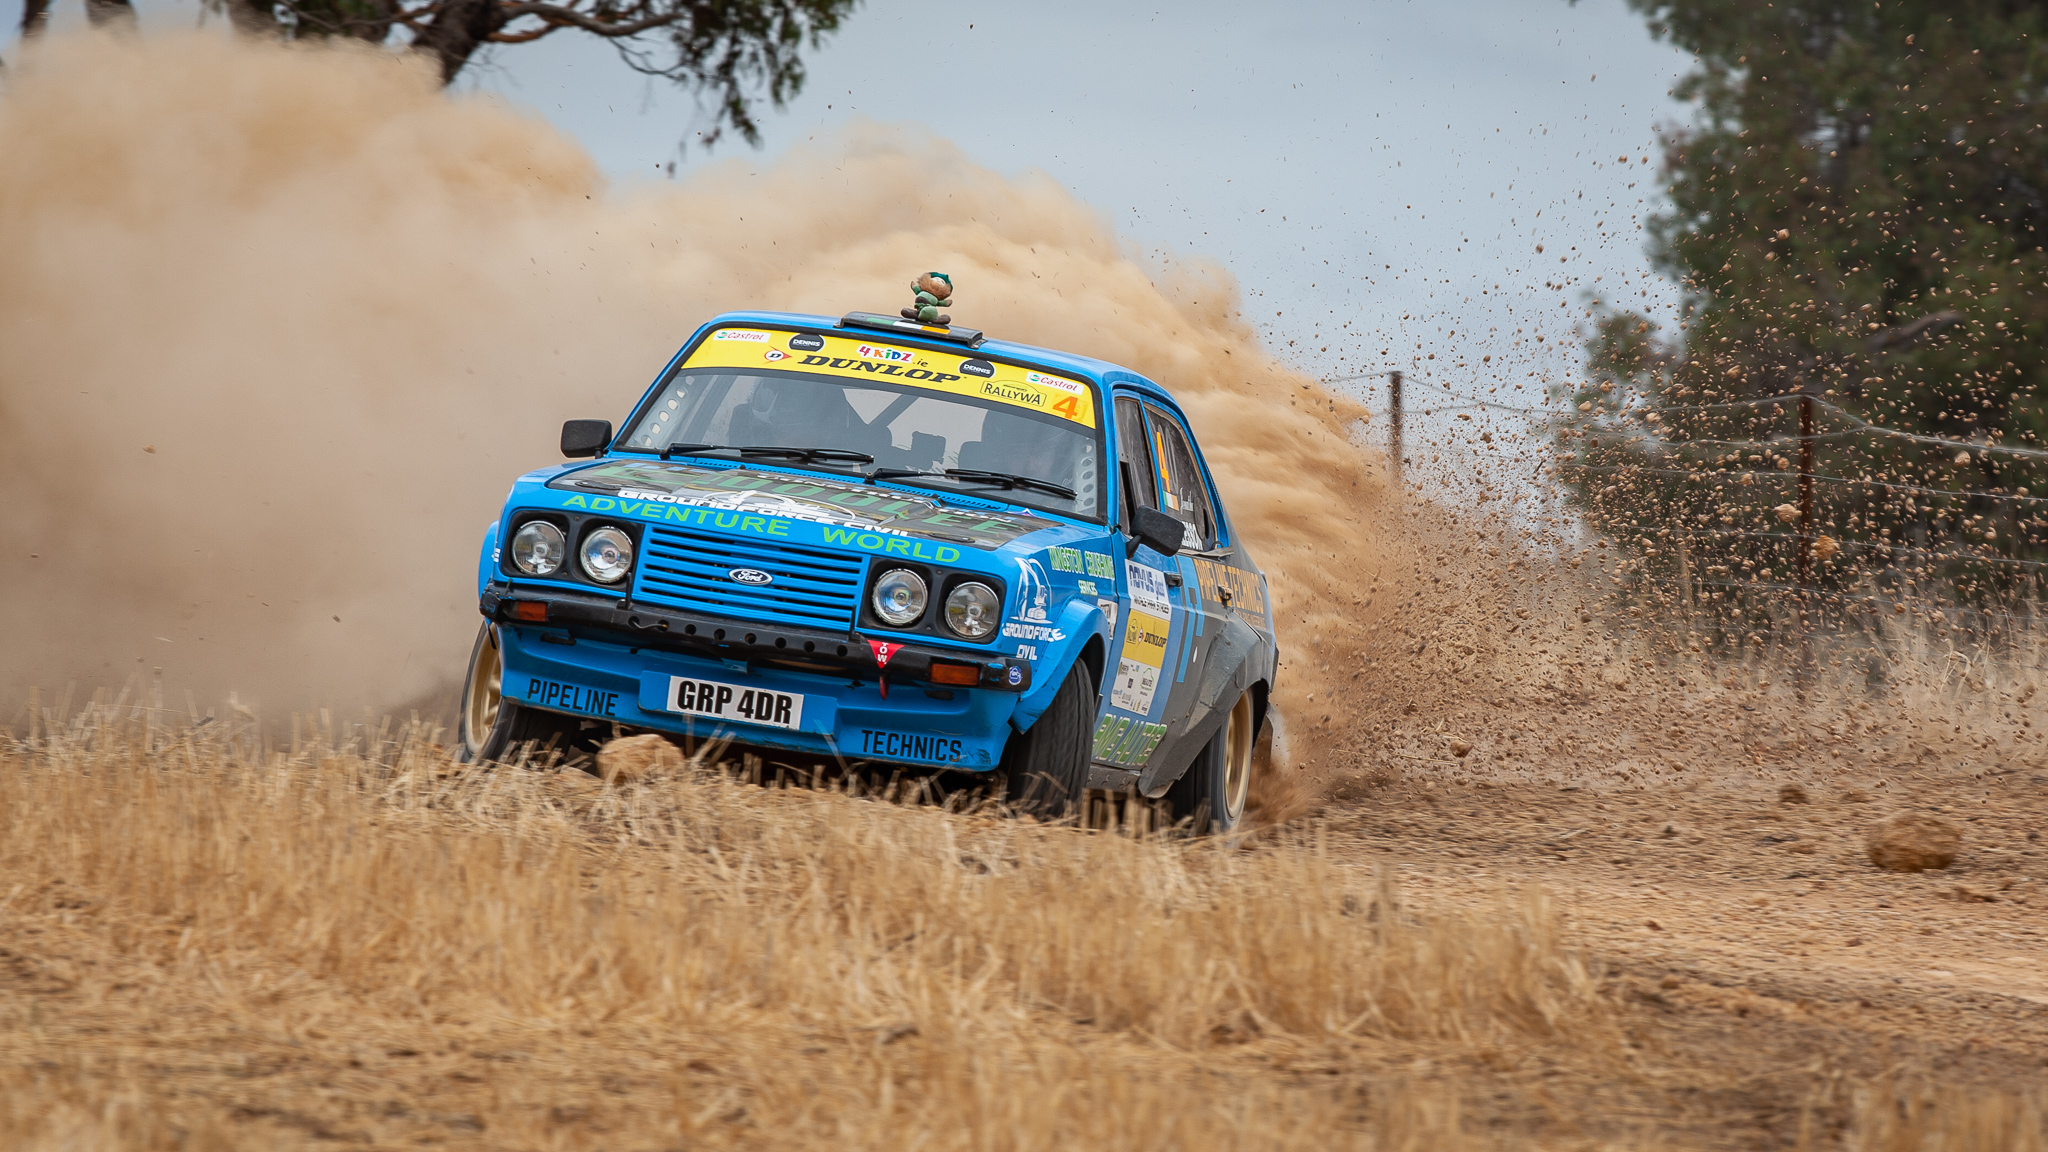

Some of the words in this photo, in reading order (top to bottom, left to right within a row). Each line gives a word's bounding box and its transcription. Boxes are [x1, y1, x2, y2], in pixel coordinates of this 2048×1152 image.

[727, 332, 764, 340] Castrol
[792, 339, 821, 347] DENNIS
[859, 346, 871, 356] 4
[798, 355, 961, 383] DUNLOP
[963, 364, 992, 375] DENNIS
[984, 383, 1041, 405] RALLYWA
[1040, 377, 1078, 391] Castrol
[1052, 396, 1078, 420] 4
[1156, 431, 1171, 493] 4
[617, 490, 838, 526] GROUNDFORCE
[562, 495, 792, 537] ADVENTURE
[823, 527, 960, 563] WORLD
[738, 570, 764, 582] Ford
[1002, 623, 1066, 643] GROUNDFORCE
[1144, 632, 1168, 648] DUNLOP
[877, 642, 889, 665] TOW
[1016, 644, 1038, 661] CIVIL
[526, 678, 619, 717] PIPELINE
[676, 680, 733, 715] GRP
[736, 689, 793, 725] 4DR
[861, 729, 962, 763] TECHNICS
